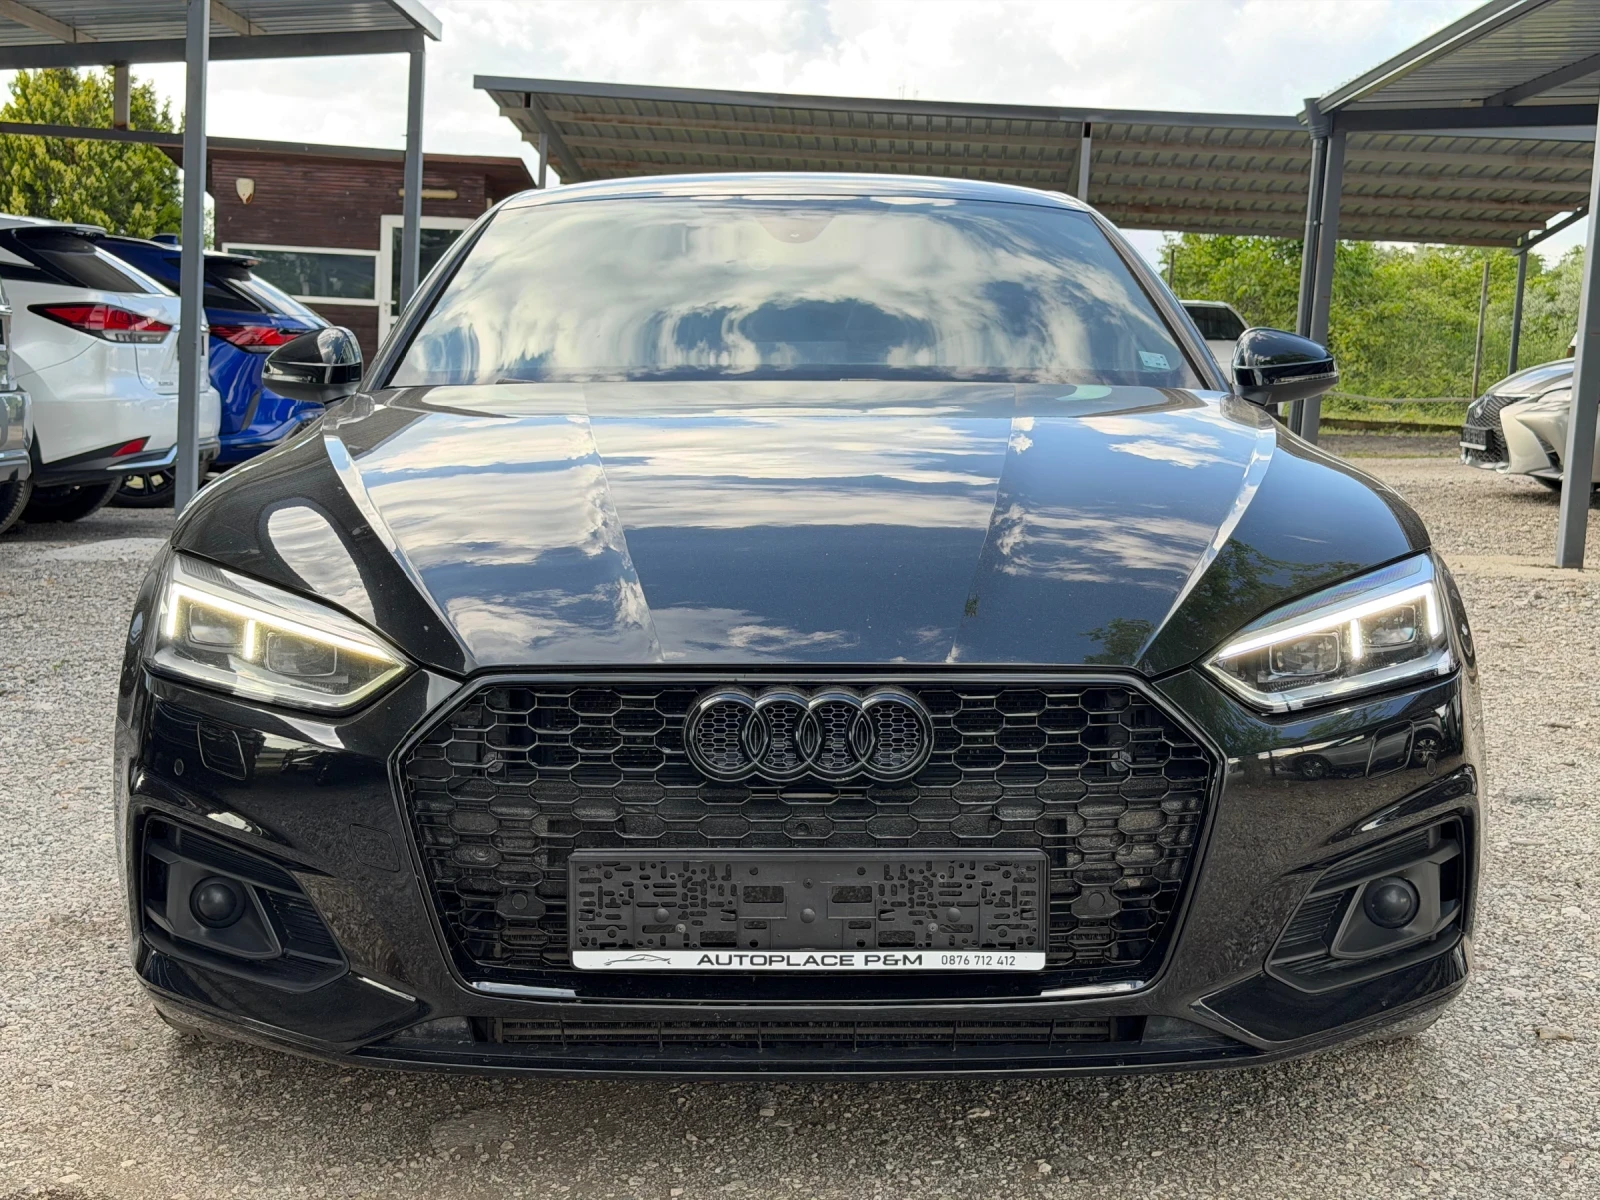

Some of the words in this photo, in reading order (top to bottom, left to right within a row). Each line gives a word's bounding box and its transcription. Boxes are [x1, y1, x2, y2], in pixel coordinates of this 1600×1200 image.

[697, 954, 855, 967] AUTOPLACE
[864, 954, 923, 966] P&M
[941, 954, 970, 966] 0876
[974, 955, 993, 966] 712
[996, 955, 1016, 966] 412
